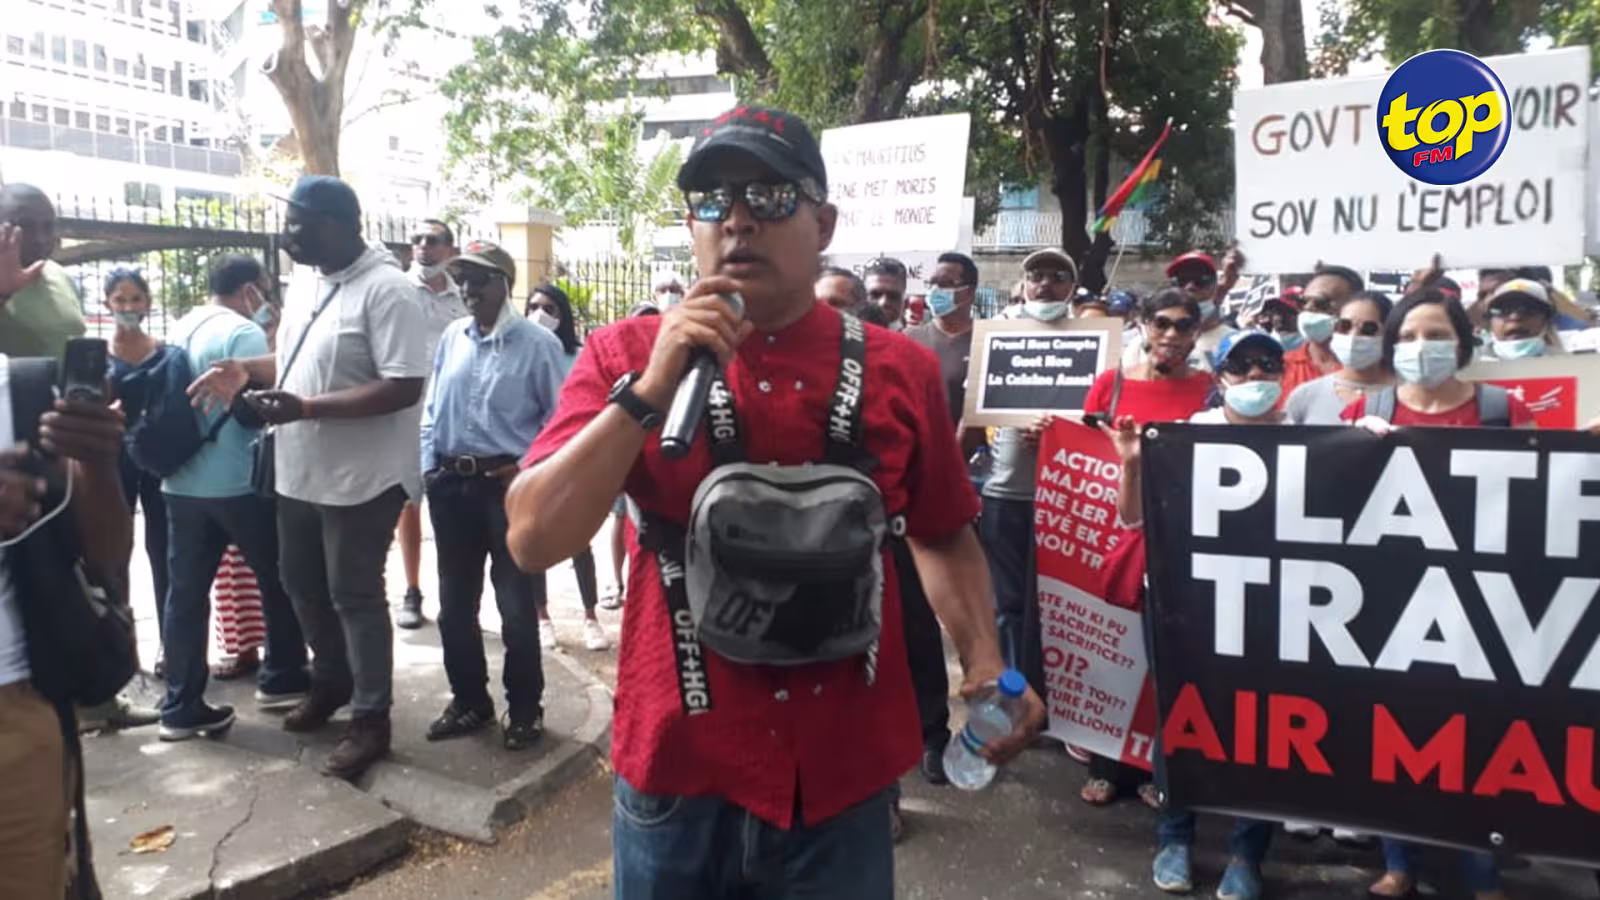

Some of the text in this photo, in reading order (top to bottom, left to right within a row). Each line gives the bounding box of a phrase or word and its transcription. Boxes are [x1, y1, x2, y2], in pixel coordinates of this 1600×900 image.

[1251, 103, 1374, 156] GOVT
[864, 179, 889, 197] MET
[895, 176, 937, 196] MORIS
[894, 206, 937, 225] MONDE
[1249, 178, 1554, 239] SOV NU L'EMPLOI
[1071, 500, 1110, 525] LER
[1191, 441, 1600, 559] PLATF
[1075, 527, 1102, 547] EK
[1049, 609, 1121, 649] SACRIFICE
[1066, 601, 1087, 617] NU
[1089, 611, 1105, 626] KI
[1107, 617, 1128, 636] PU
[1047, 624, 1136, 670] SACRIFICE??
[1058, 674, 1084, 694] FER
[1088, 686, 1128, 711] TOI??
[1084, 699, 1105, 716] PU
[1053, 706, 1124, 740] MILLIONS
[1162, 682, 1334, 777] AIR
